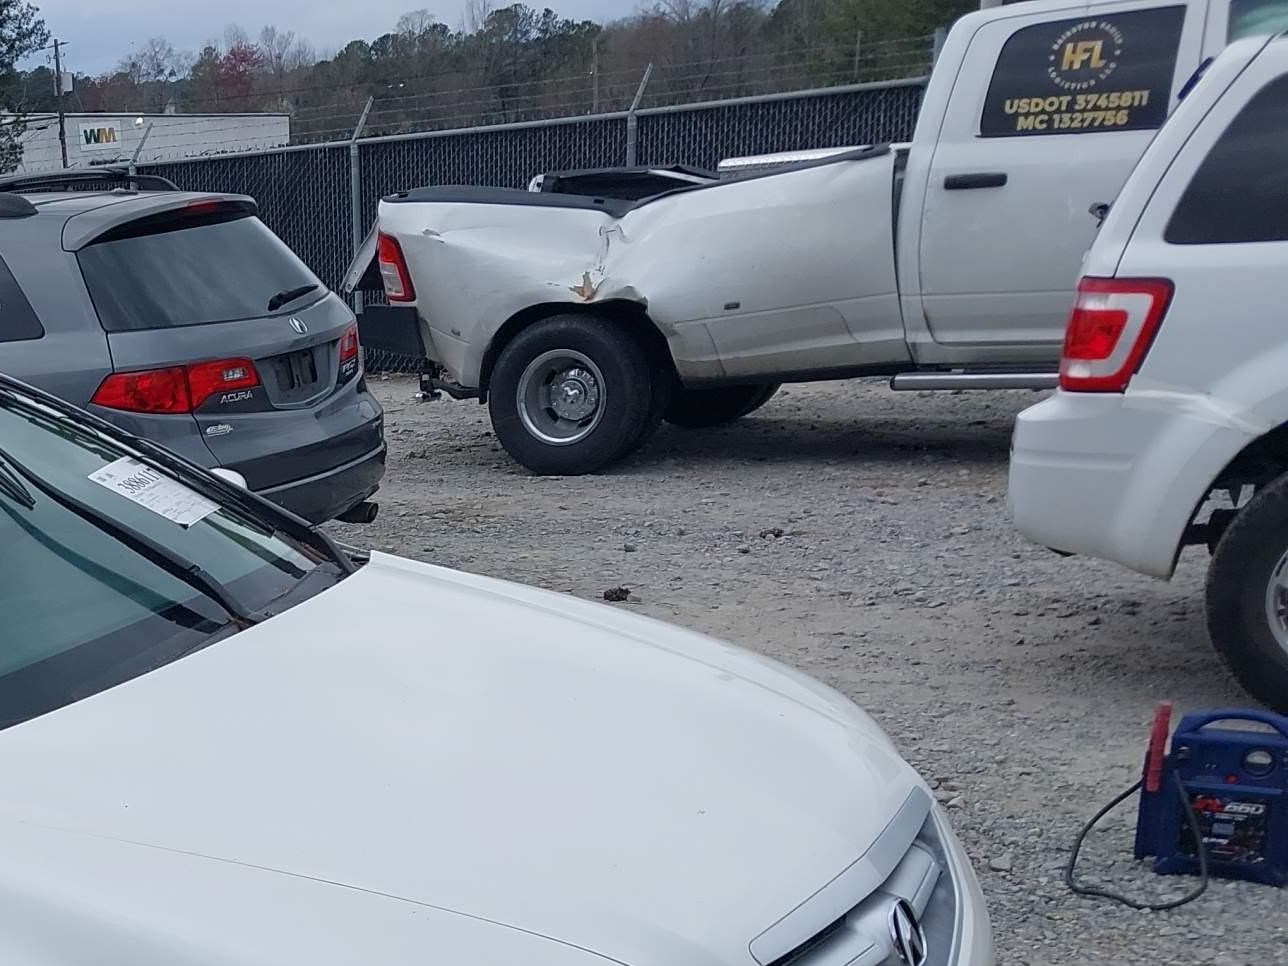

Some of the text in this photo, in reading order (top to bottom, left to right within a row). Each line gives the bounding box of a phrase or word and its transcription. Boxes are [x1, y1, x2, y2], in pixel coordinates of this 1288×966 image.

[1005, 90, 1150, 113] USDOT 3745811
[1016, 110, 1128, 131] MC 1327756
[83, 127, 117, 145] WM
[220, 390, 253, 404] ACURA
